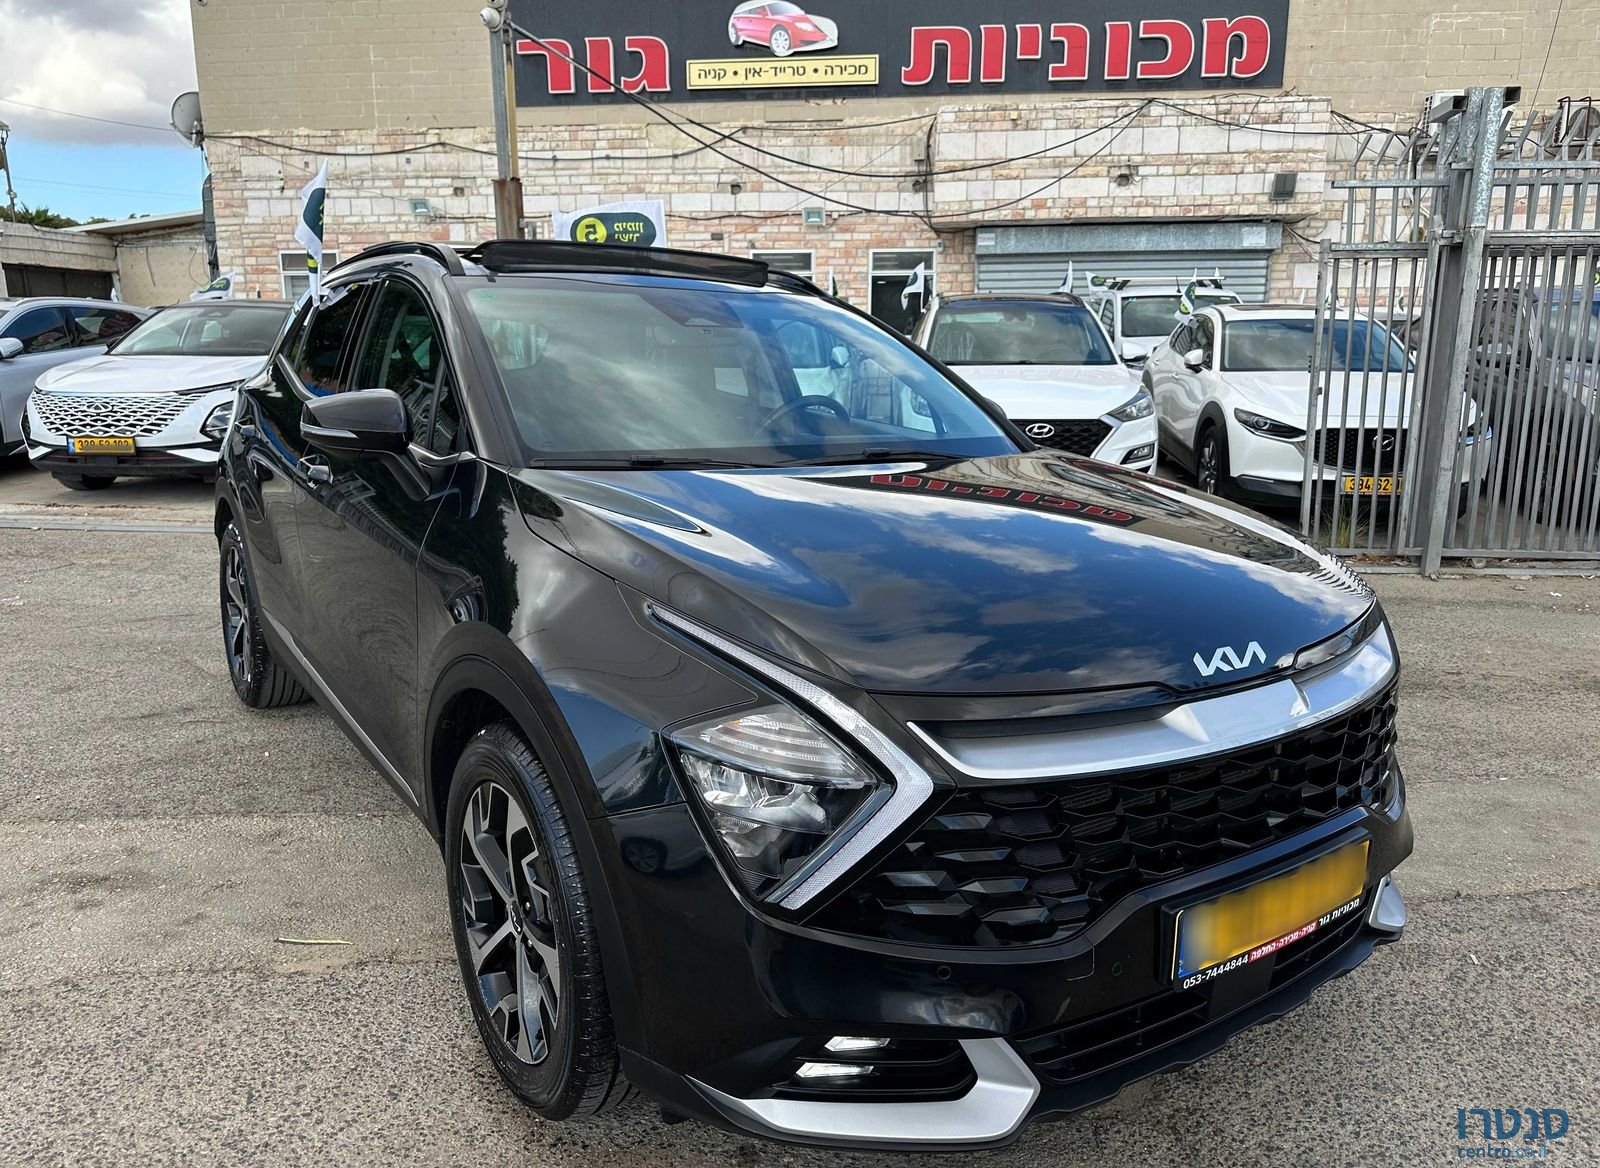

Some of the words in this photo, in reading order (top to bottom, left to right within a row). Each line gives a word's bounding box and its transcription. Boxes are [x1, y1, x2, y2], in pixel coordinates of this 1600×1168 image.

[901, 15, 1270, 85] מכוניות
[516, 36, 671, 93] גור
[698, 67, 727, 80] קניה
[745, 65, 806, 80] טרייד-אין
[824, 63, 868, 76] מכירה
[1193, 641, 1266, 676] KIA
[1318, 914, 1330, 926] גור
[1331, 898, 1360, 920] מכוניות
[1183, 954, 1249, 989] 053-7444844
